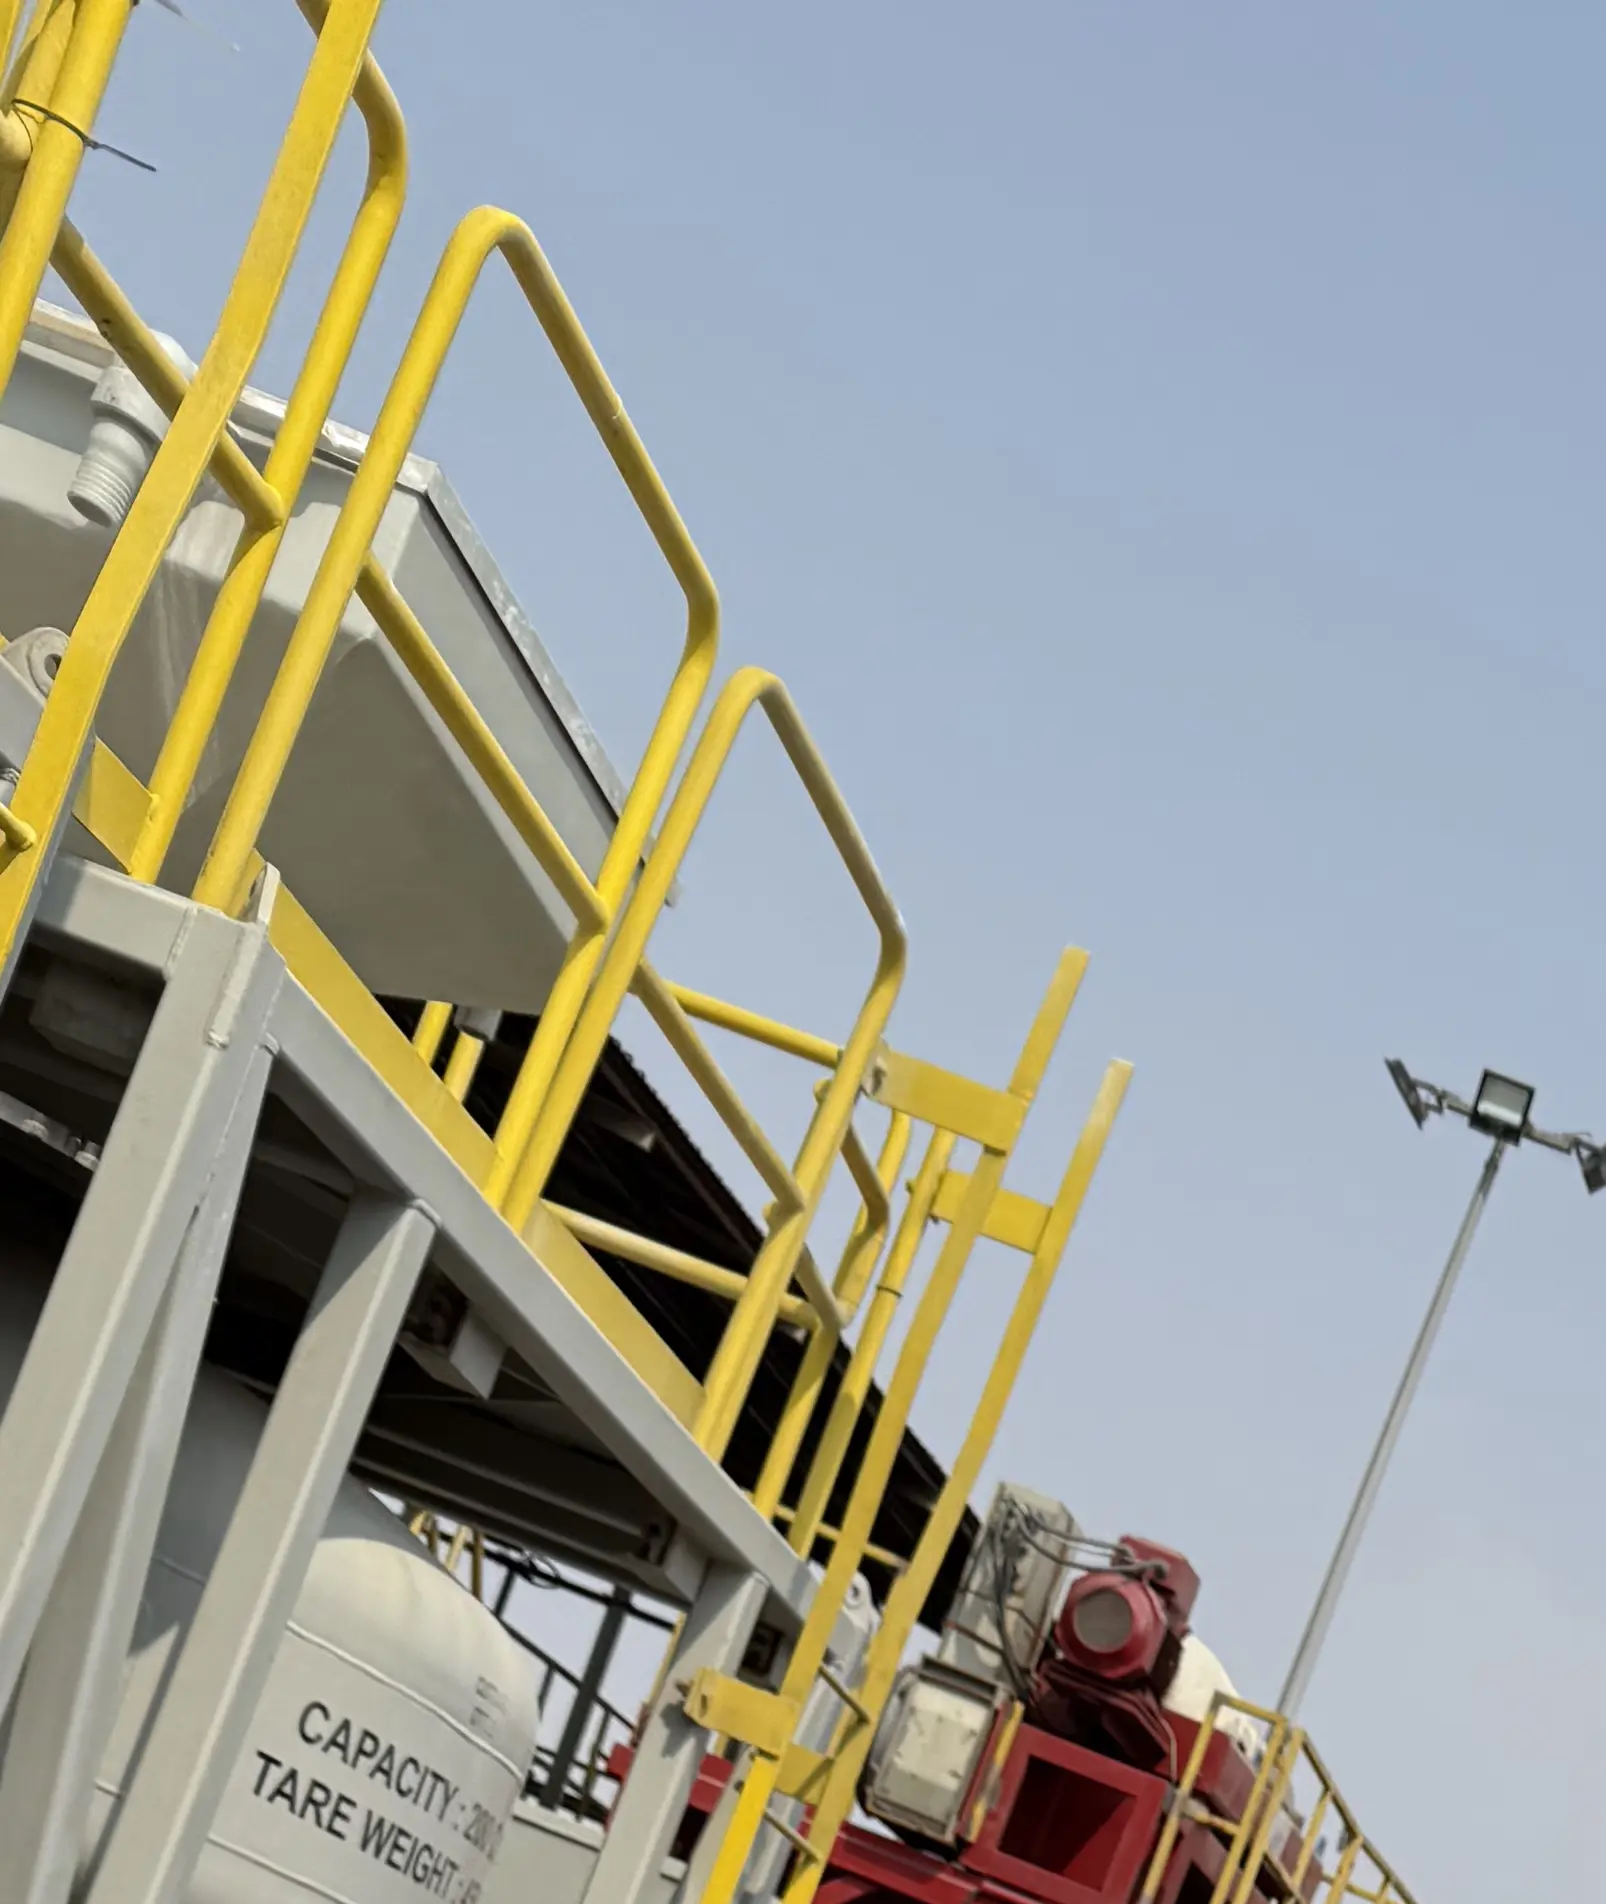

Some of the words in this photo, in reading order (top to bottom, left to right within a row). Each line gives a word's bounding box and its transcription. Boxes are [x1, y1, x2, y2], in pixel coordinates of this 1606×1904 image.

[254, 1750, 358, 1841] TARE
[360, 1809, 460, 1899] WEIGHT
[297, 1701, 460, 1822] CAPACITY
